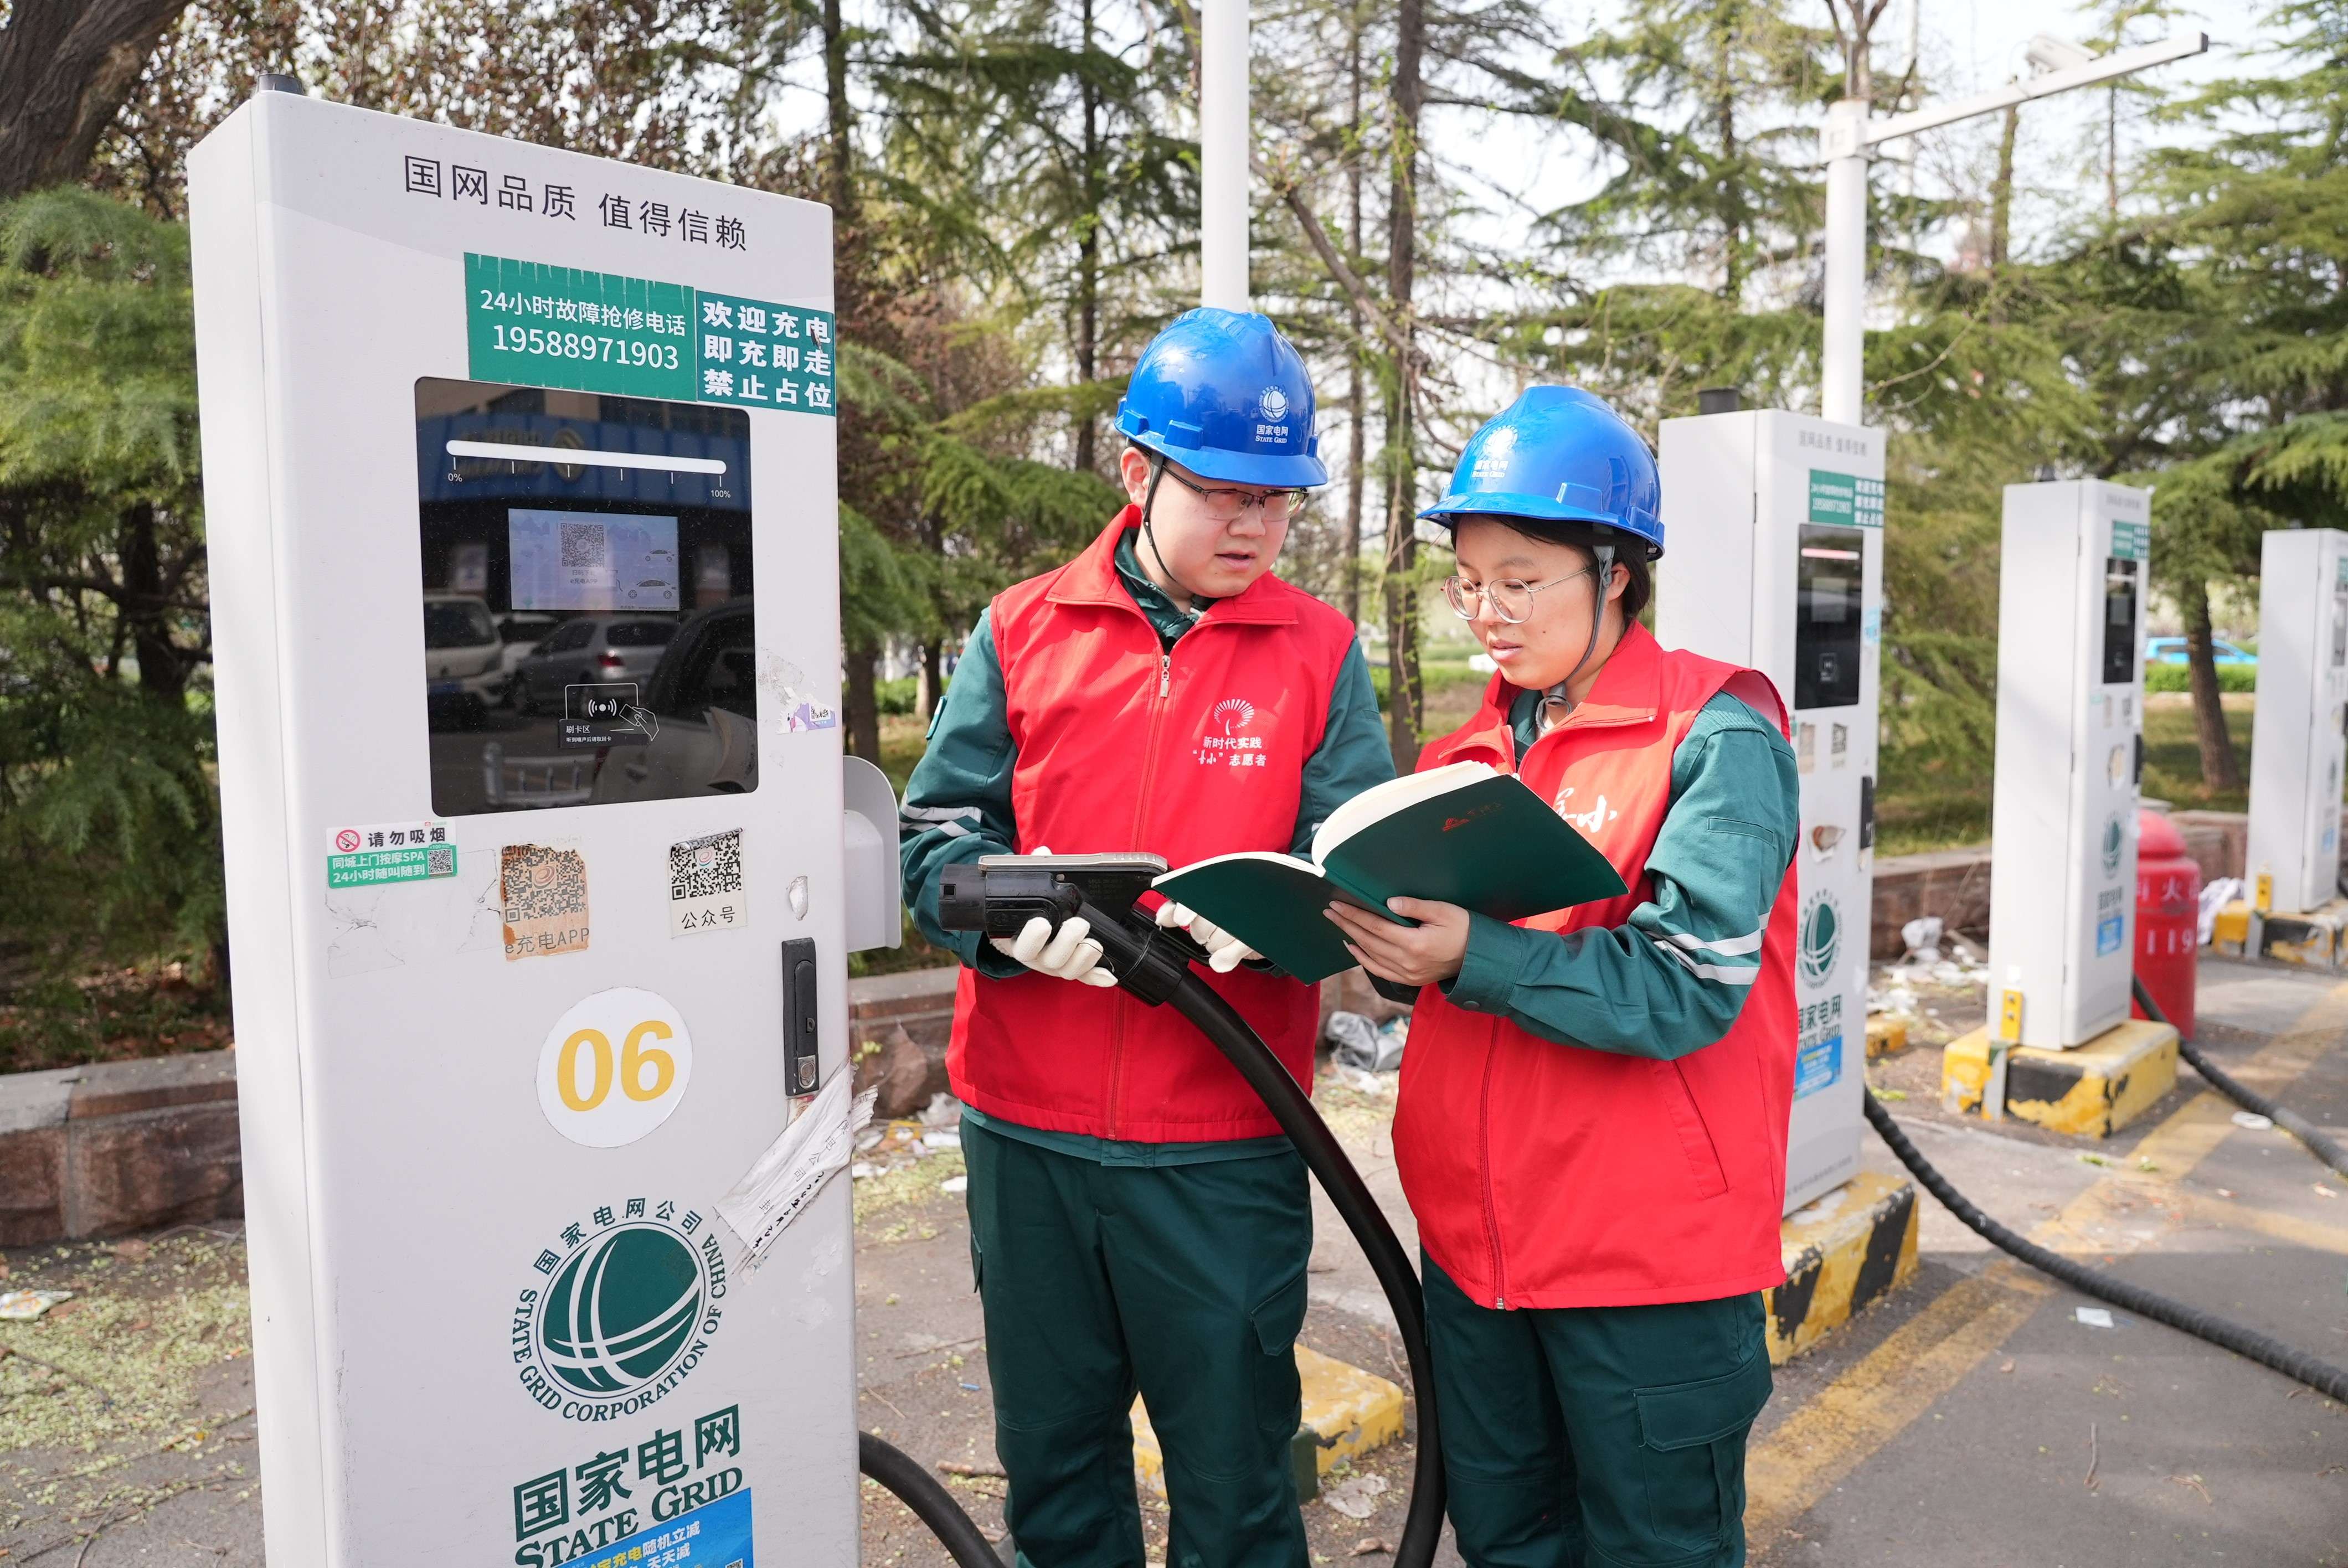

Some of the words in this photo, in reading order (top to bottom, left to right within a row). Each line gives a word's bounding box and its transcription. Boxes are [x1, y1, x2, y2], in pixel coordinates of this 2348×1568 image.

[405, 154, 576, 221] 国网品质
[599, 193, 746, 251] 值得信赖
[481, 289, 686, 337] 24小时故障抢修电话
[703, 300, 829, 344] 欢迎充电
[493, 324, 678, 369] 19588971903
[704, 335, 831, 376] 即充即走
[704, 368, 831, 408] 禁止占位
[1257, 425, 1288, 436] 国家电网
[447, 472, 463, 483] 0%
[710, 489, 731, 499] 100%
[566, 725, 590, 734] 刷卡区
[1203, 736, 1262, 750] 新时代实践
[1229, 754, 1266, 767] 志愿者
[368, 827, 445, 848] 请勿吸烟
[333, 852, 425, 869] 同城上门按摩SPA
[333, 864, 425, 883] 24小时随叫随到
[682, 906, 735, 930] 公众号
[505, 927, 589, 955] e充电APP
[2146, 929, 2195, 955] 119
[557, 1020, 675, 1111] 06
[533, 1198, 703, 1275] 国家电网公司
[701, 1233, 727, 1299] CHINA
[513, 1289, 538, 1363] STATE
[703, 1304, 722, 1334] OF
[519, 1365, 562, 1410] GRID
[563, 1339, 709, 1421] CORPORATION
[513, 1404, 740, 1542] 国家电网
[514, 1508, 639, 1568] STATE
[651, 1467, 743, 1521] GRID
